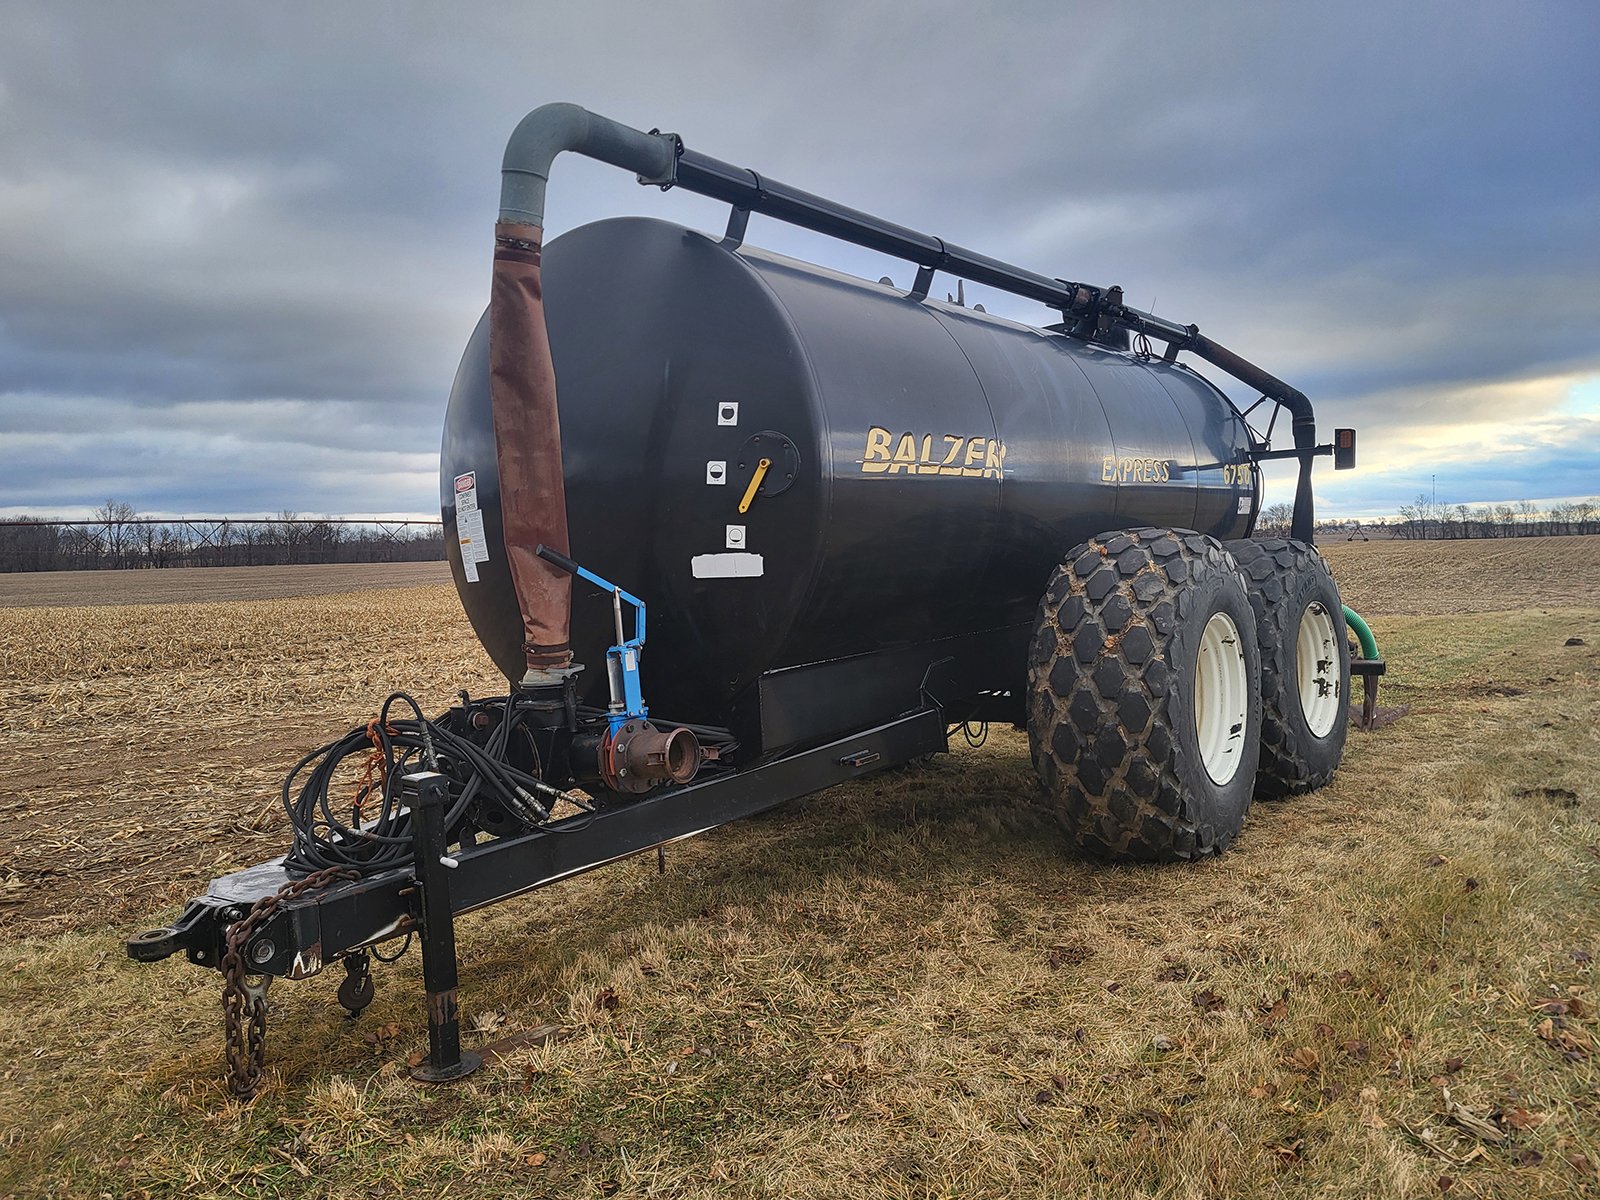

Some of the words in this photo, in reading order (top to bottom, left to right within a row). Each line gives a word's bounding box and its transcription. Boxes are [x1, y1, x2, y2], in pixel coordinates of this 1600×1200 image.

[862, 425, 1007, 479] BALZER
[1101, 456, 1170, 483] EXPRESS
[1223, 464, 1250, 486] 6750
